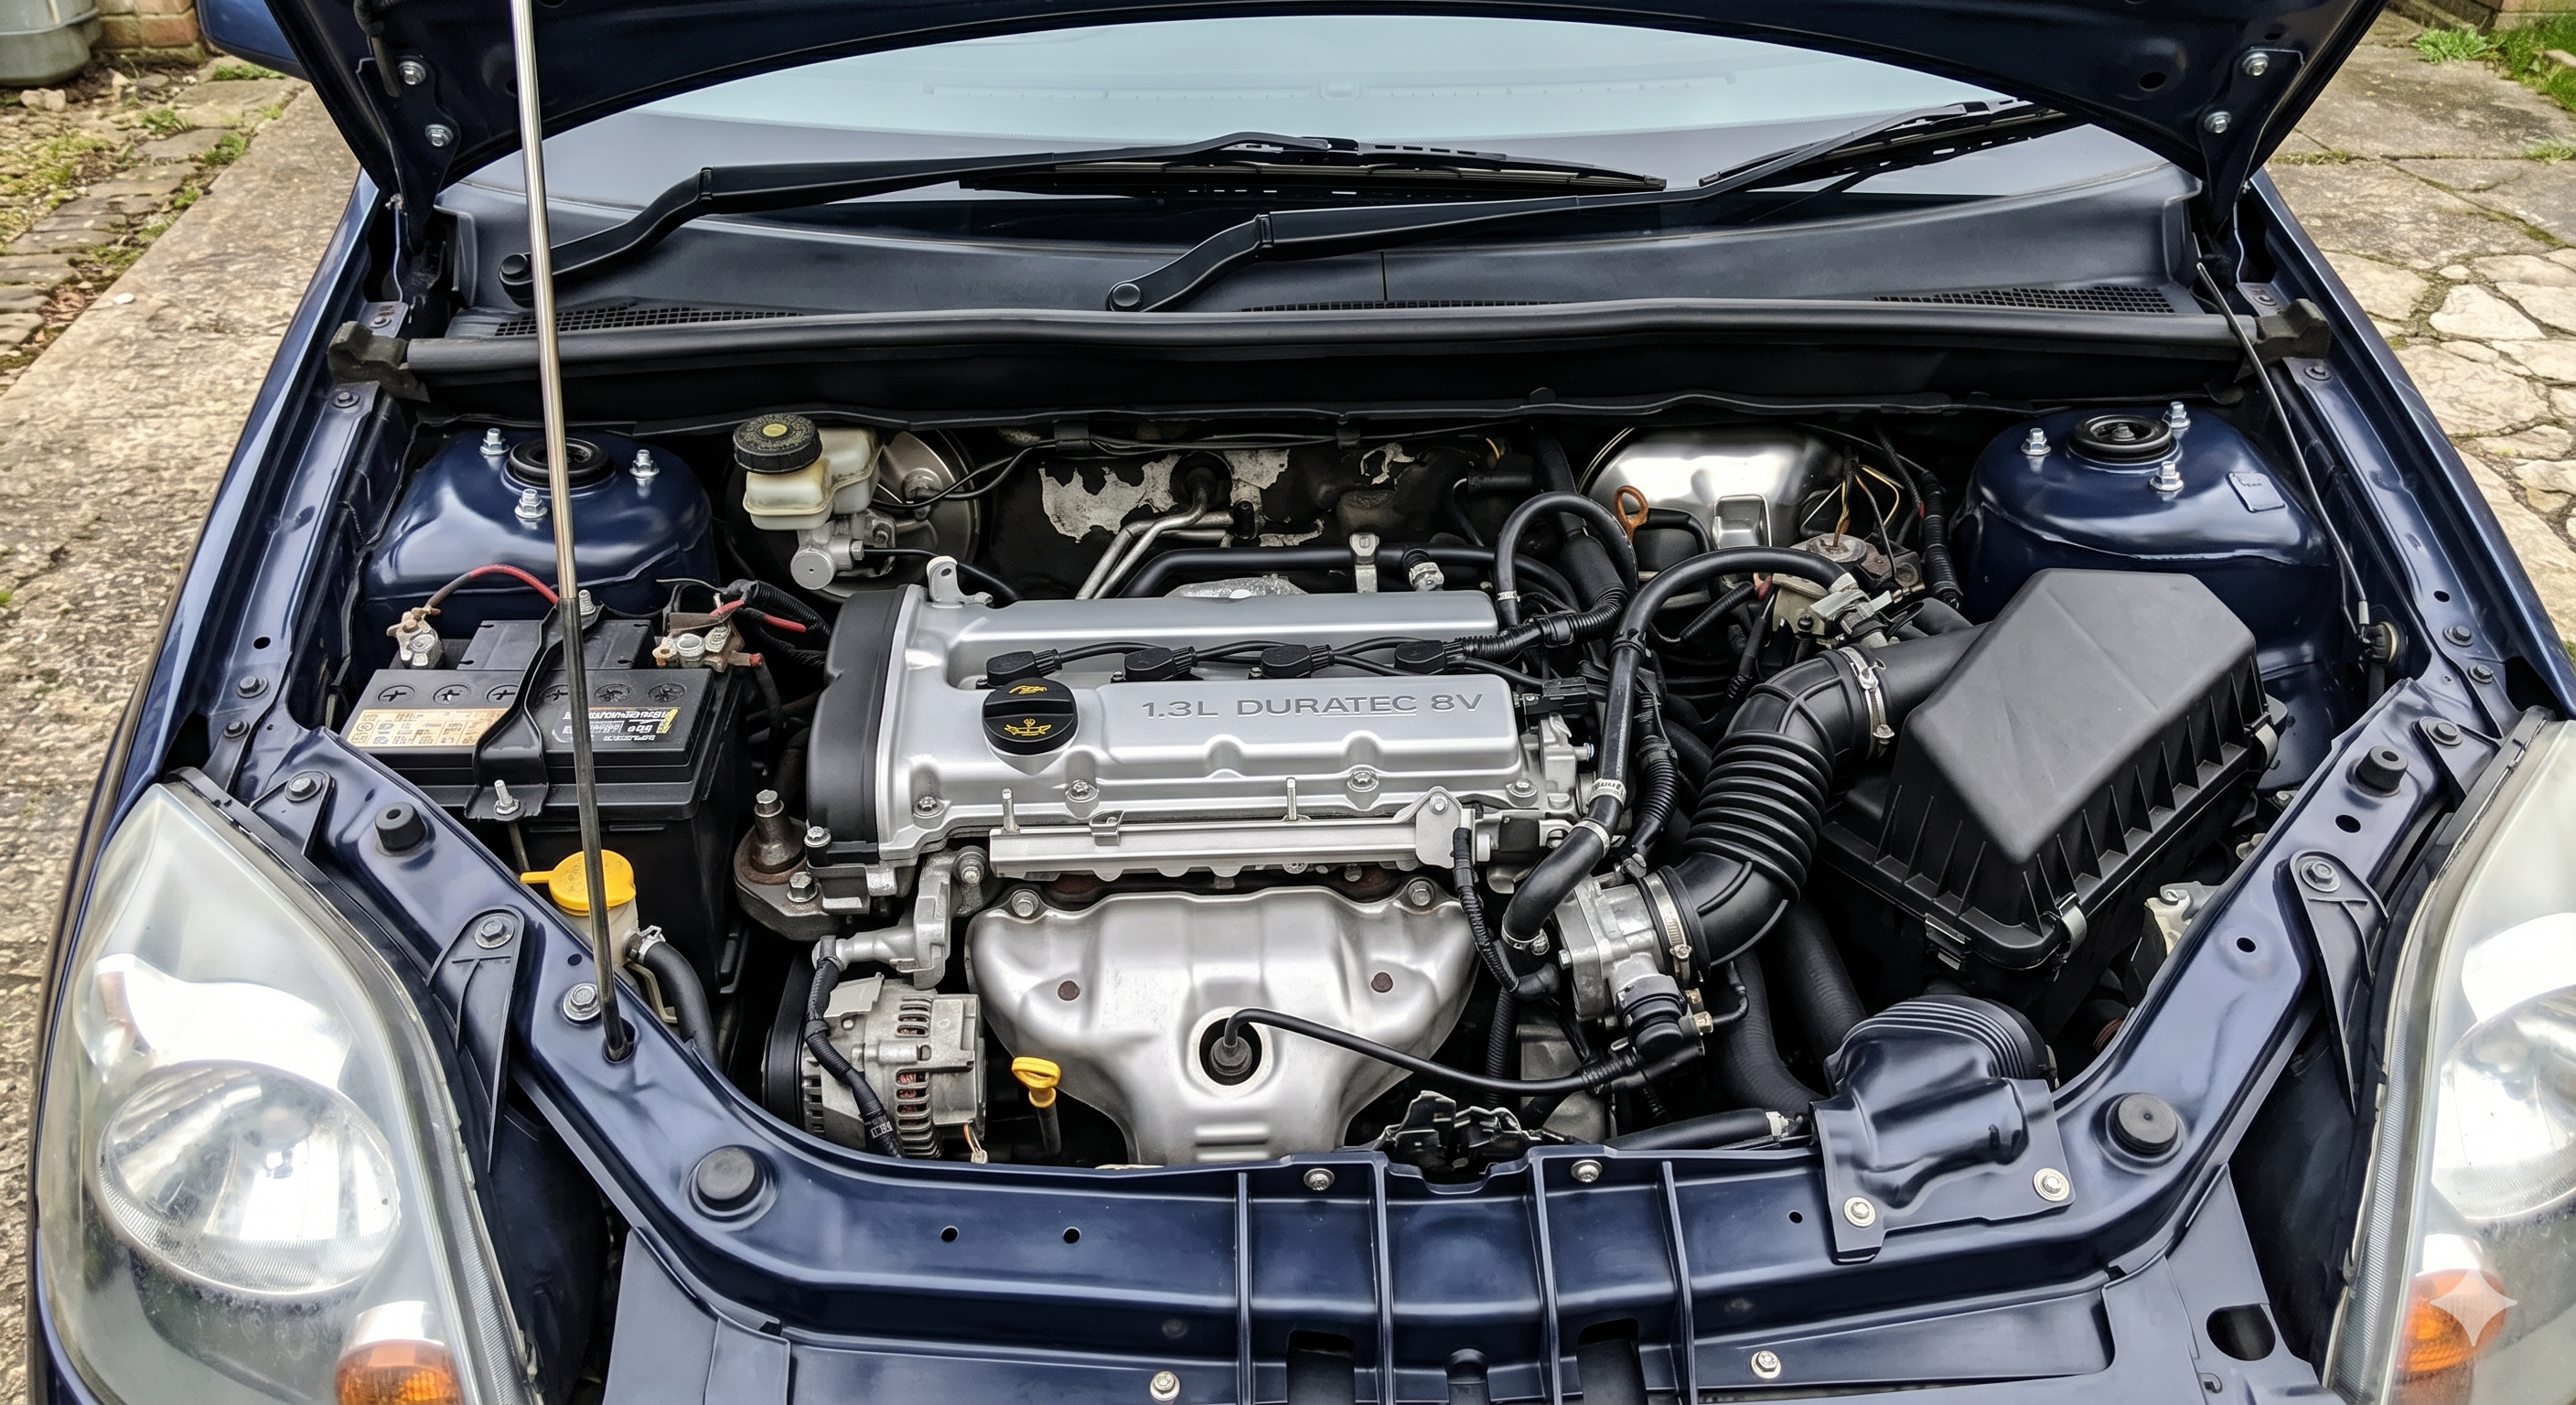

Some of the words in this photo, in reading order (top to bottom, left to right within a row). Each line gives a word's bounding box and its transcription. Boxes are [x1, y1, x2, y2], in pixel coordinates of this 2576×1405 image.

[1142, 700, 1219, 719] 1.3L
[1237, 695, 1418, 717] DURATEC
[1430, 693, 1484, 713] 8V
